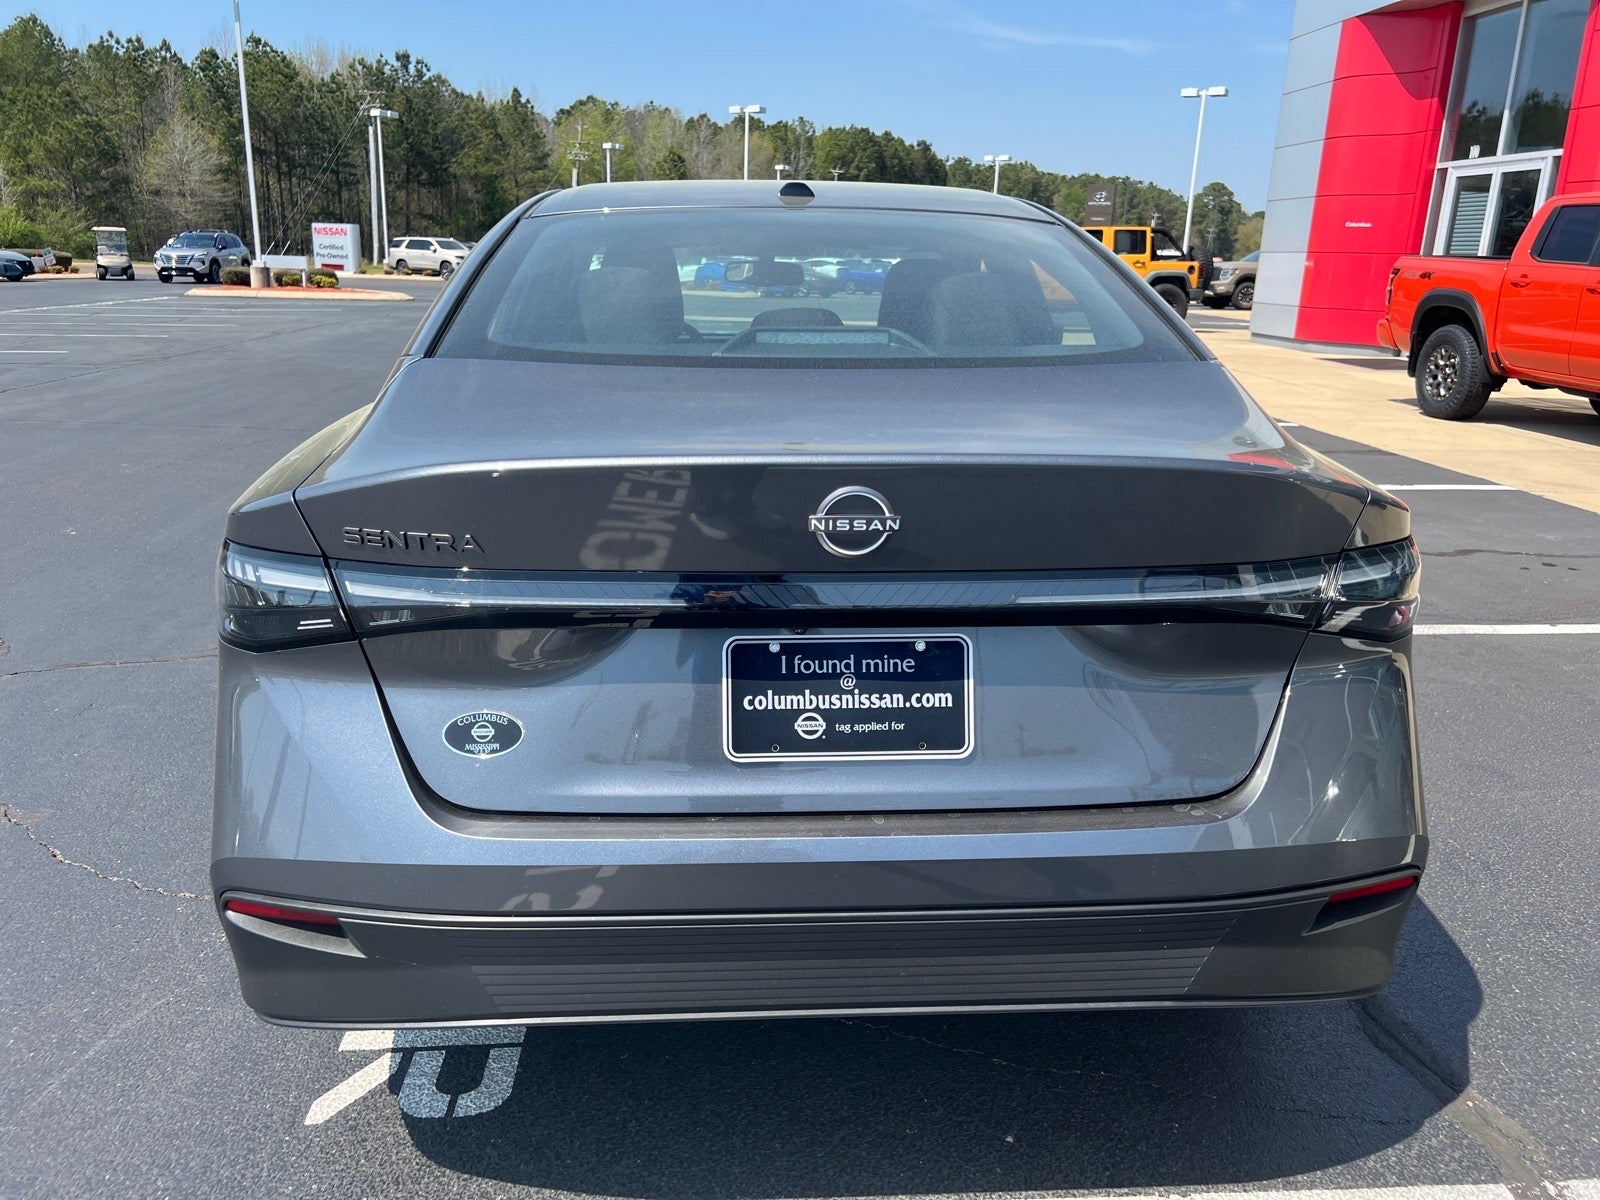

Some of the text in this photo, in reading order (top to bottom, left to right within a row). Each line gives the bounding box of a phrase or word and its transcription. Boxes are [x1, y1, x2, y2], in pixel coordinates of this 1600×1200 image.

[314, 227, 347, 236] NISSAN
[319, 243, 344, 251] Certified
[315, 252, 349, 260] Pre-Owned
[811, 518, 900, 531] NISSAN
[342, 526, 486, 554] SENTRA
[781, 655, 916, 674] I found mine
[840, 674, 856, 690] @
[743, 689, 953, 710] columbusnissan.com
[458, 713, 508, 726] COLUMBUS
[835, 721, 905, 733] tag applied for
